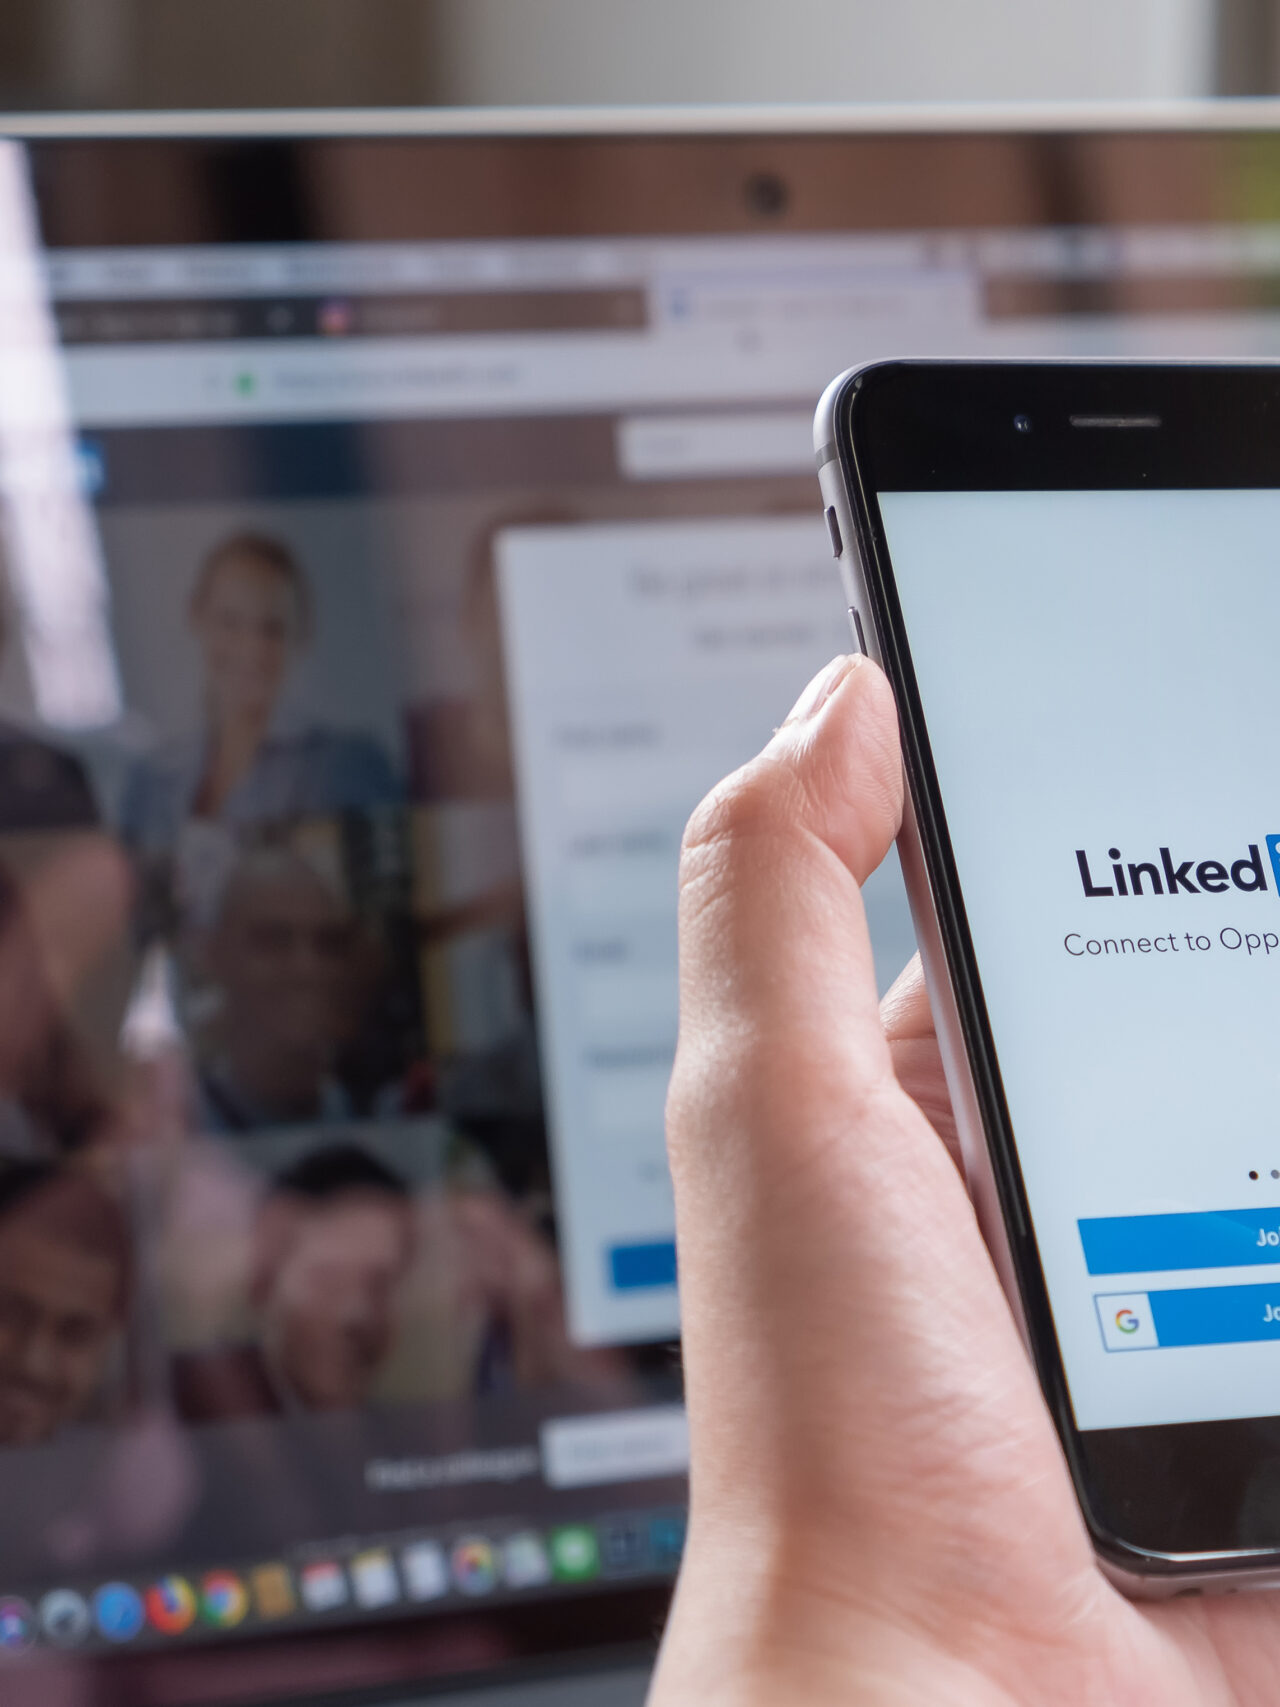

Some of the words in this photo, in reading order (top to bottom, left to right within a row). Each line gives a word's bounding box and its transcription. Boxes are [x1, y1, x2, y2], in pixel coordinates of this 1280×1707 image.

[1063, 933, 1179, 956] Connect
[1184, 932, 1211, 951] to
[1115, 1309, 1140, 1334] G
